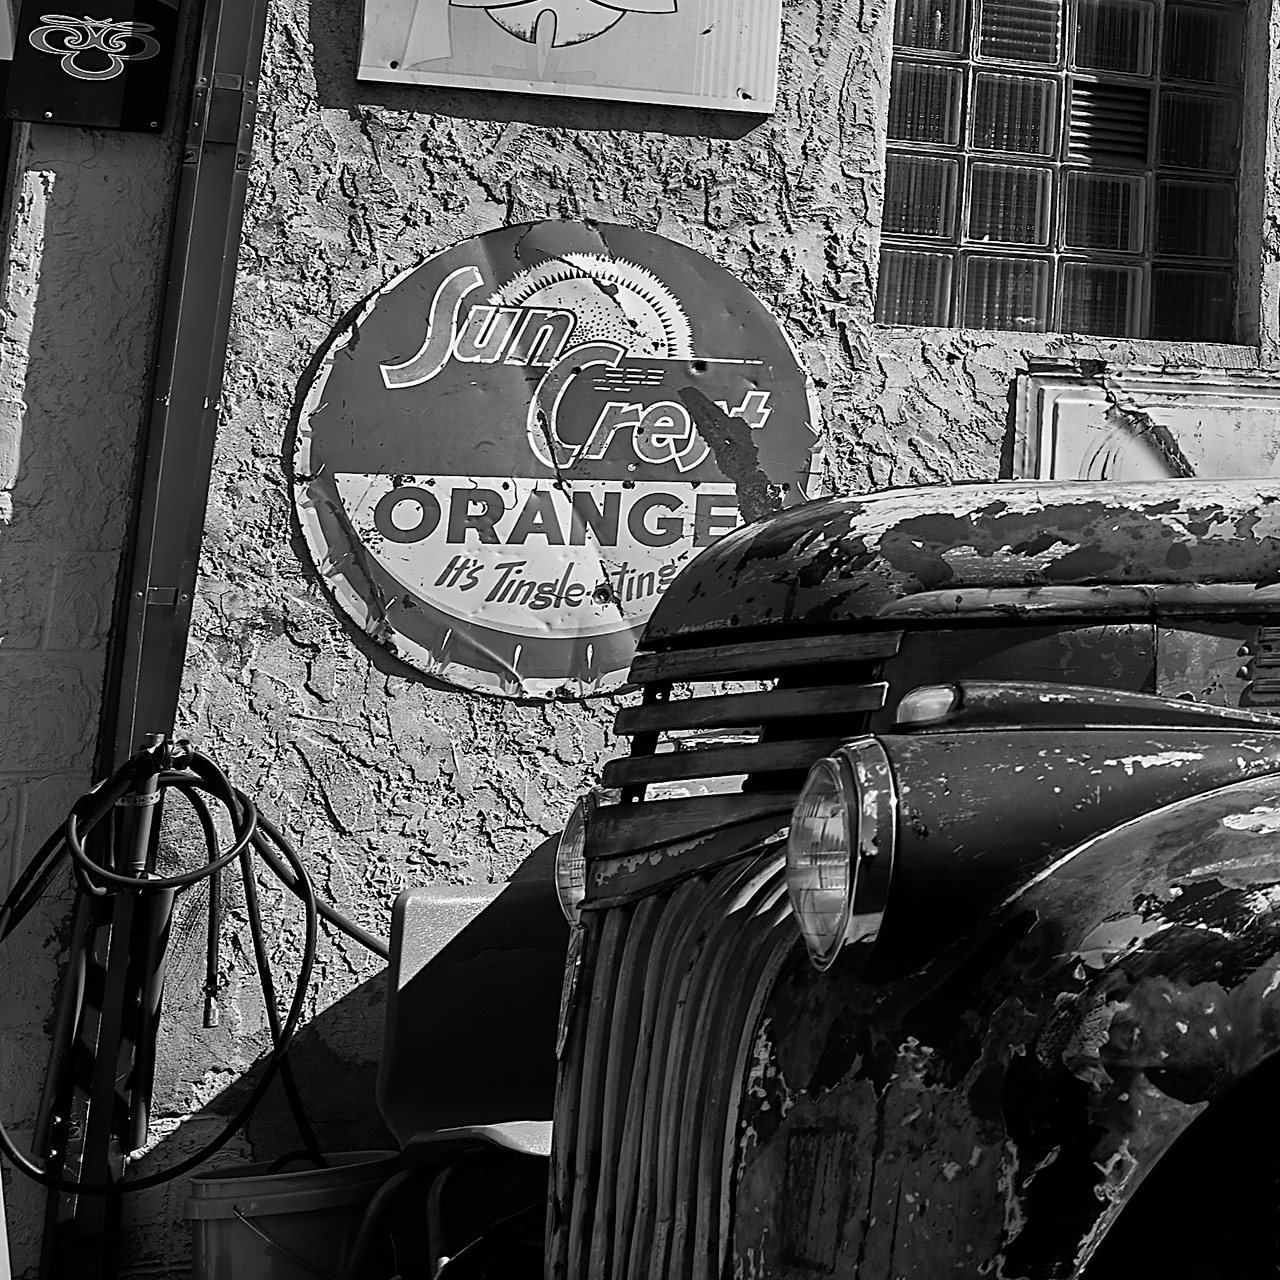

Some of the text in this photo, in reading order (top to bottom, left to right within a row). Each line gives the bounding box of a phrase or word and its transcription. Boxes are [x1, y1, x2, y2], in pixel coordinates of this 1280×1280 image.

[379, 265, 579, 390] Sun
[373, 486, 739, 549] ORANGE
[434, 554, 678, 611] It's Tingle-ting
